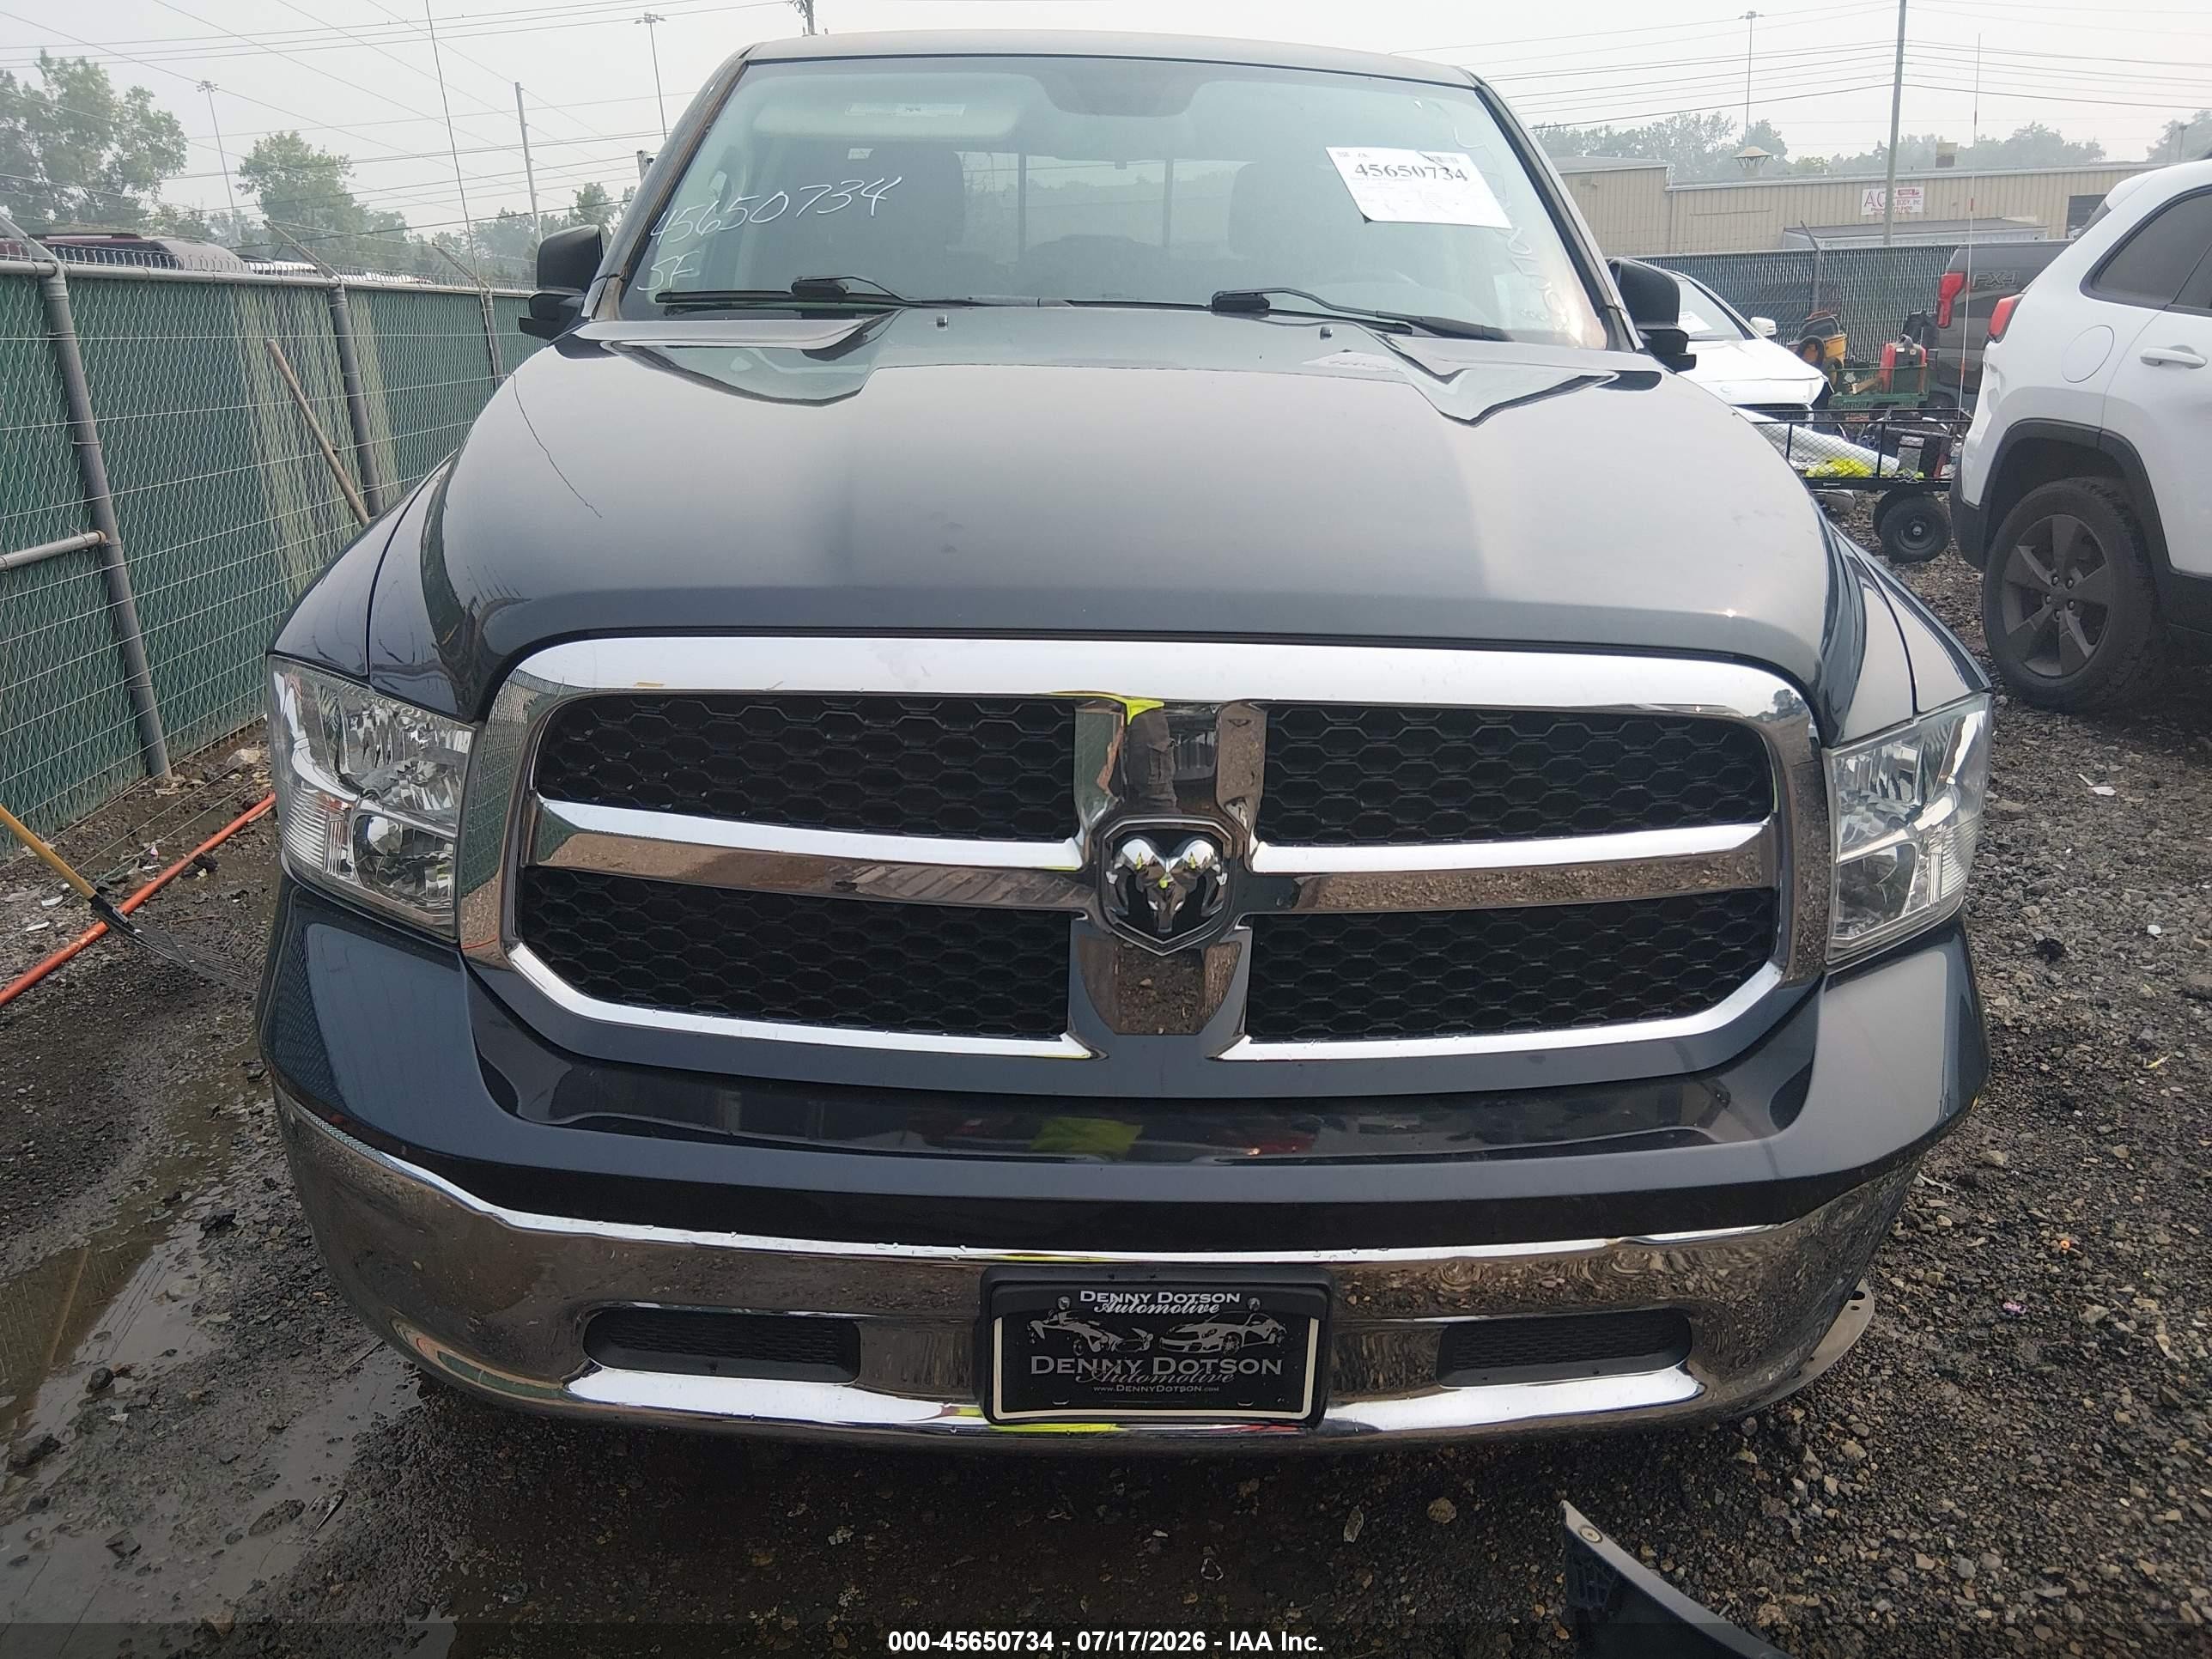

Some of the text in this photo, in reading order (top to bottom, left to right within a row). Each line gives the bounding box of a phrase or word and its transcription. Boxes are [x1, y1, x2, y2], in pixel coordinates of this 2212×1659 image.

[1354, 163, 1468, 181] 45650734
[650, 176, 902, 246] 45650734
[1971, 270, 2020, 289] FX4
[1079, 1291, 1241, 1304] DENNY DOTSON
[1093, 1297, 1220, 1315] Automotive
[1030, 1355, 1283, 1376] DENNY DOTSON
[1075, 1366, 1235, 1383] Automotive
